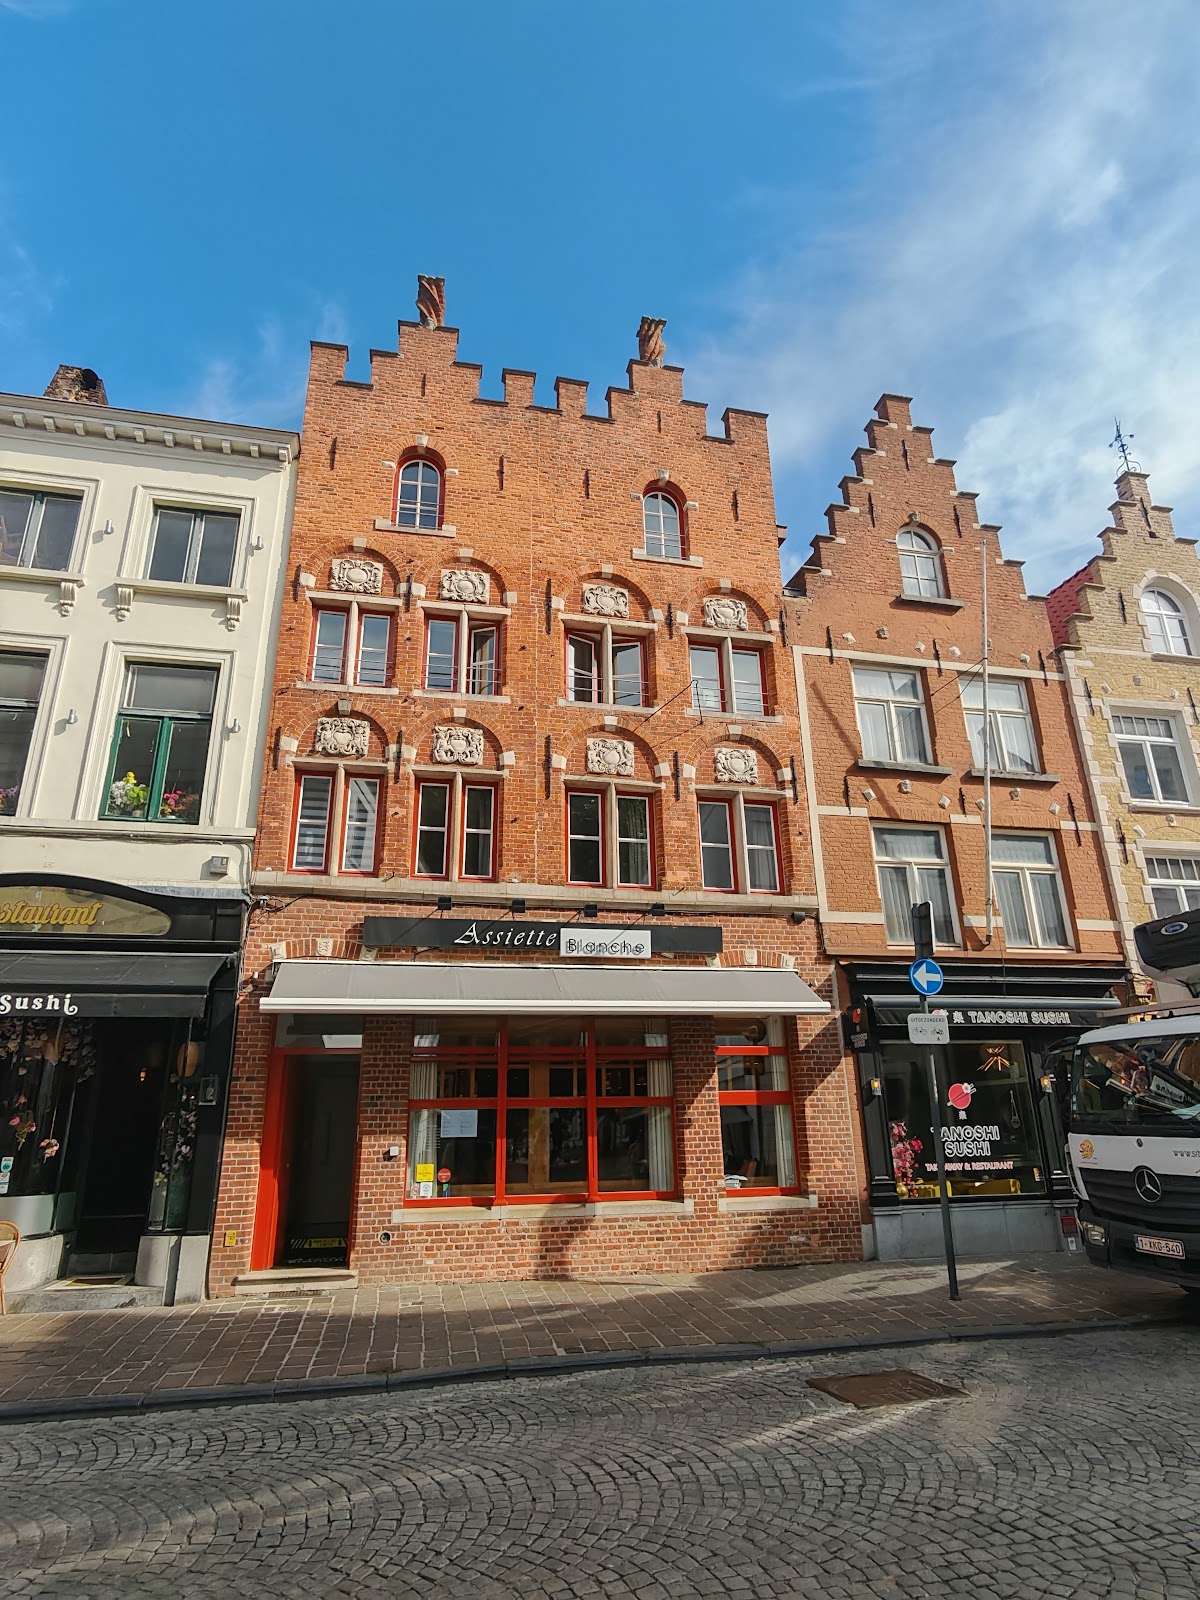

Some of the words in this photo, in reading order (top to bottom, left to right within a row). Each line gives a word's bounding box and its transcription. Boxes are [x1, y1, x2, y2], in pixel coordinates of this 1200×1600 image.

[0, 900, 103, 925] staurant
[453, 921, 558, 947] Assiette
[566, 938, 646, 955] Blanche
[0, 994, 79, 1015] Sushi
[968, 1011, 1029, 1024] TANOSHI
[1031, 1011, 1071, 1024] SUSHI
[930, 1125, 1001, 1141] ANOSHI
[945, 1141, 991, 1157] SUSHI
[925, 1163, 939, 1171] TAK
[971, 1161, 1014, 1170] RESTAURANT
